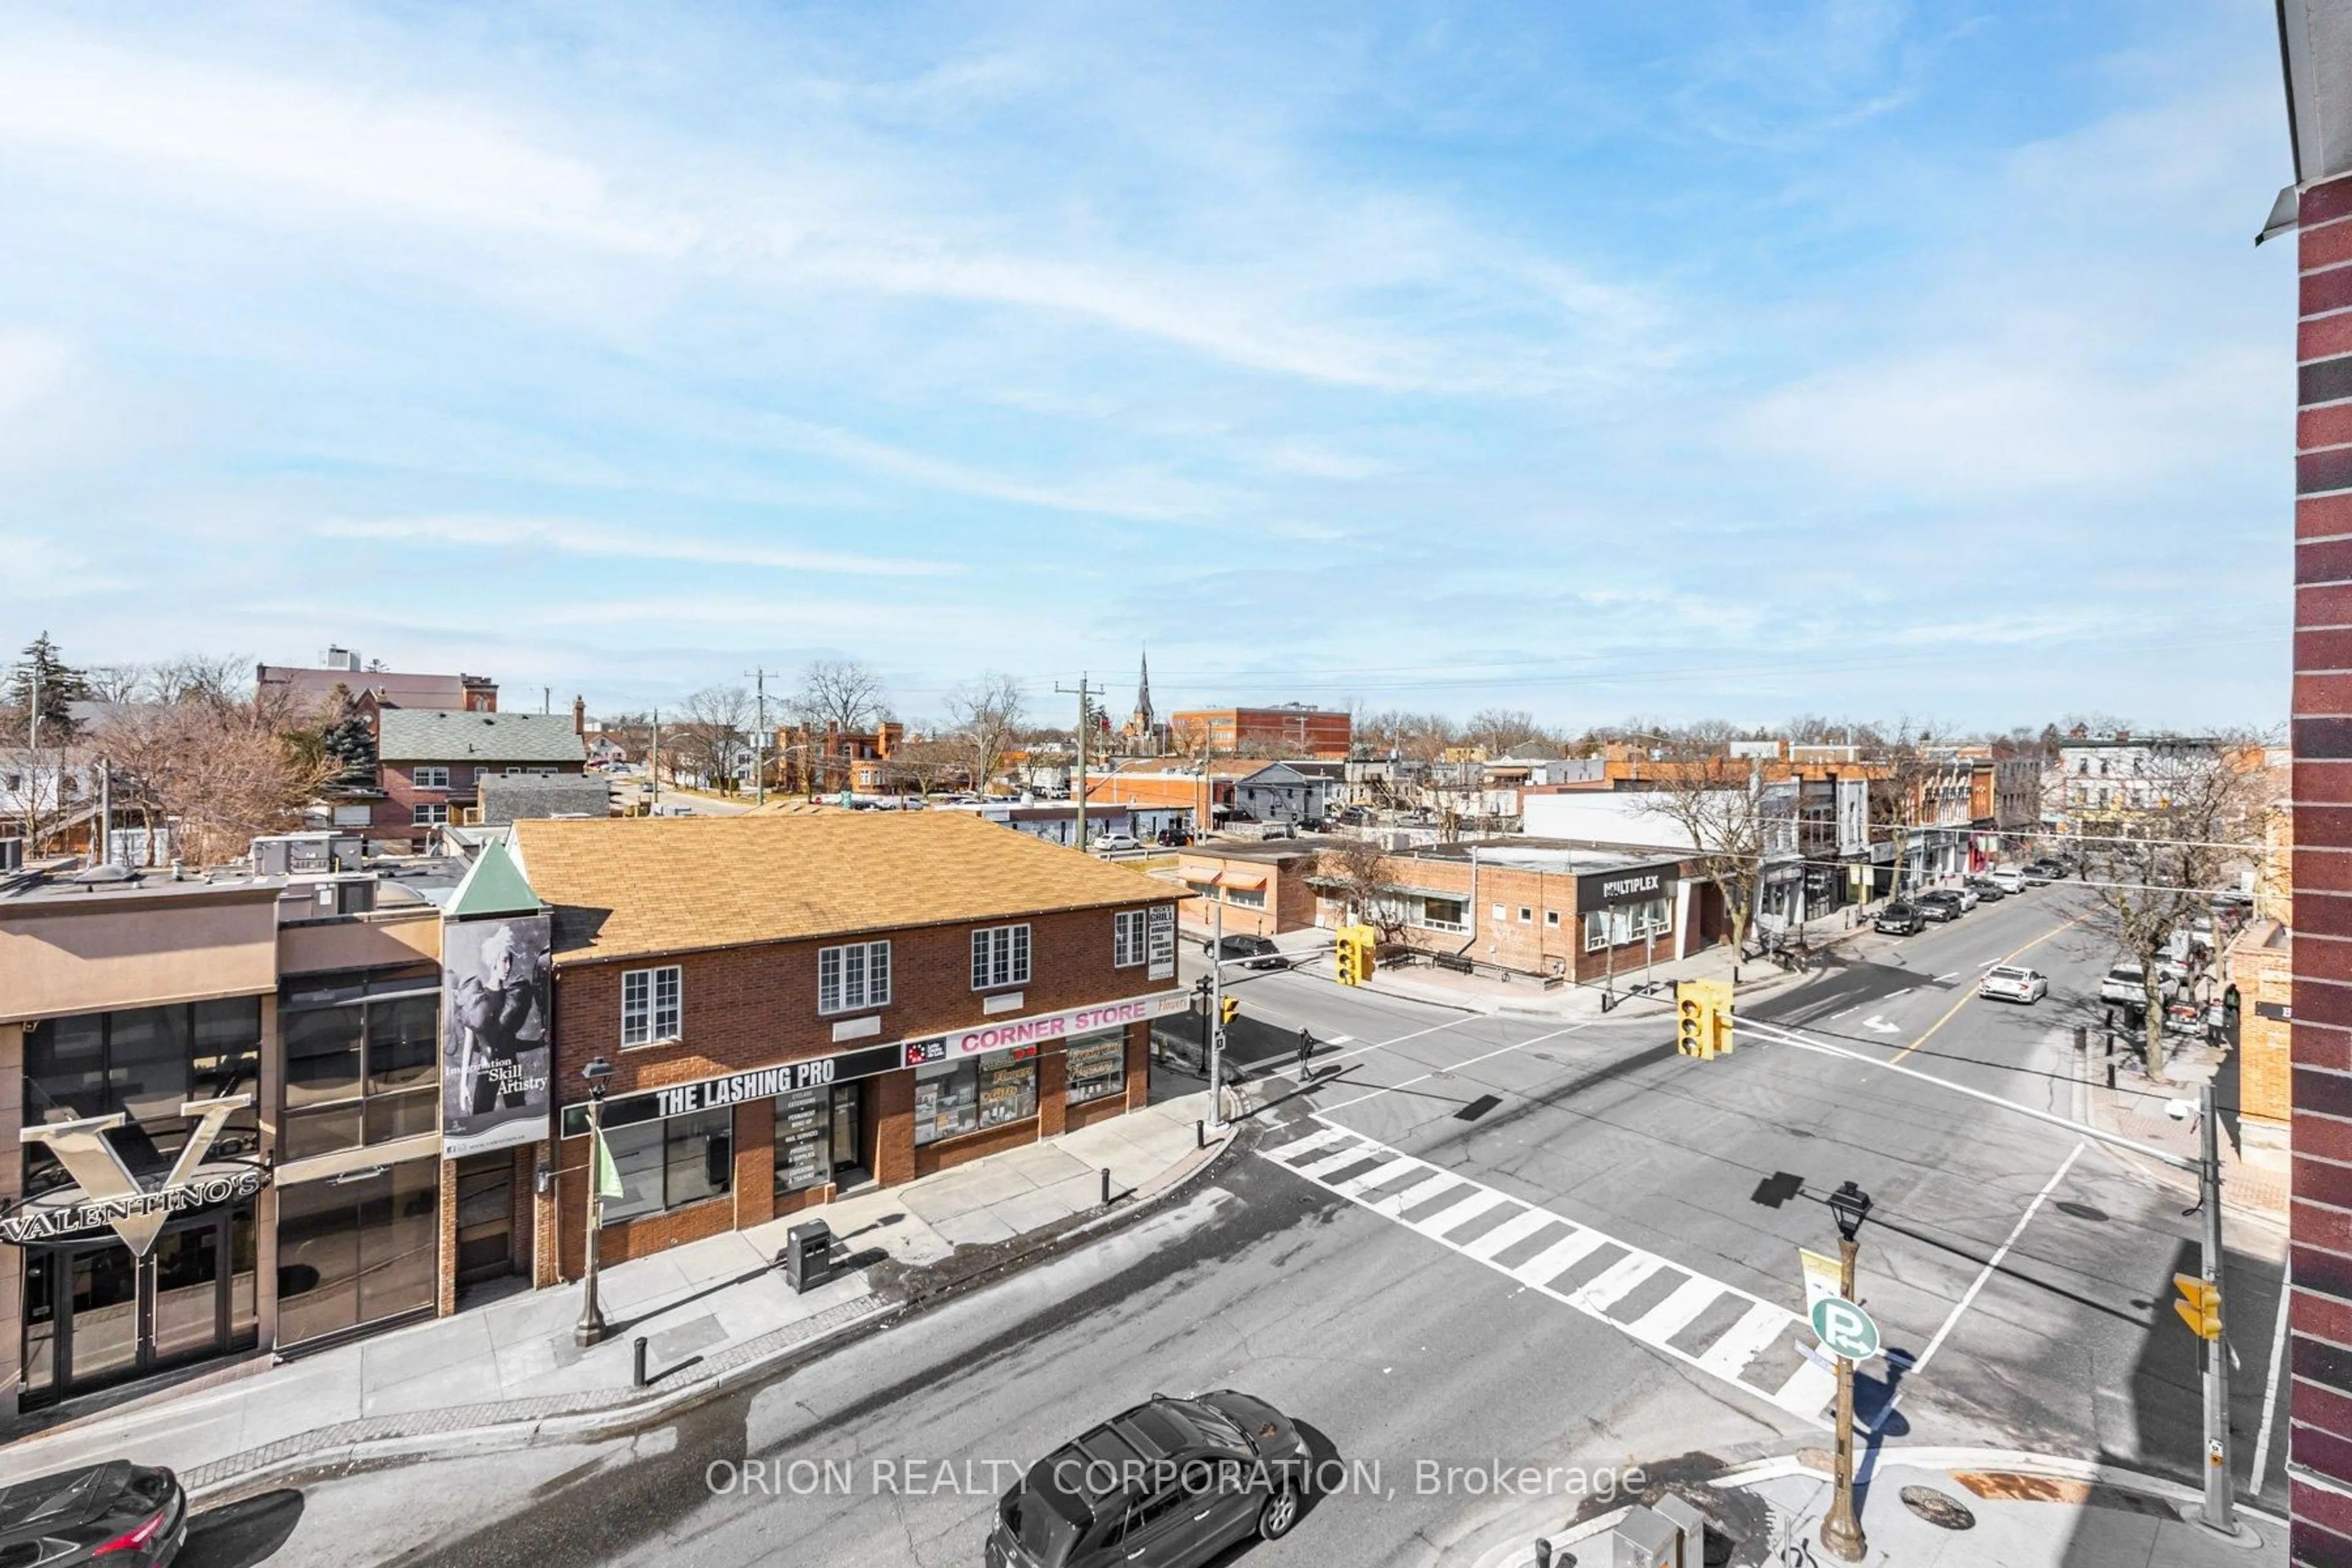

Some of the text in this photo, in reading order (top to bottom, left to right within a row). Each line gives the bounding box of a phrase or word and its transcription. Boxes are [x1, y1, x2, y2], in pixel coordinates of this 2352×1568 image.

[1603, 875, 1659, 897] MULTIPLEX
[1150, 911, 1172, 922] GRILL
[1157, 998, 1187, 1012] Flowers
[962, 1017, 1065, 1052] CORNER
[1076, 1001, 1145, 1030] STORE
[489, 1064, 522, 1082] Skill
[497, 1076, 548, 1096] Artistry
[657, 1058, 835, 1117] THE LASHING PRO
[797, 1129, 818, 1139] SERVICES
[1, 1170, 260, 1242] VALENTINO'S
[1826, 1303, 1863, 1345] P
